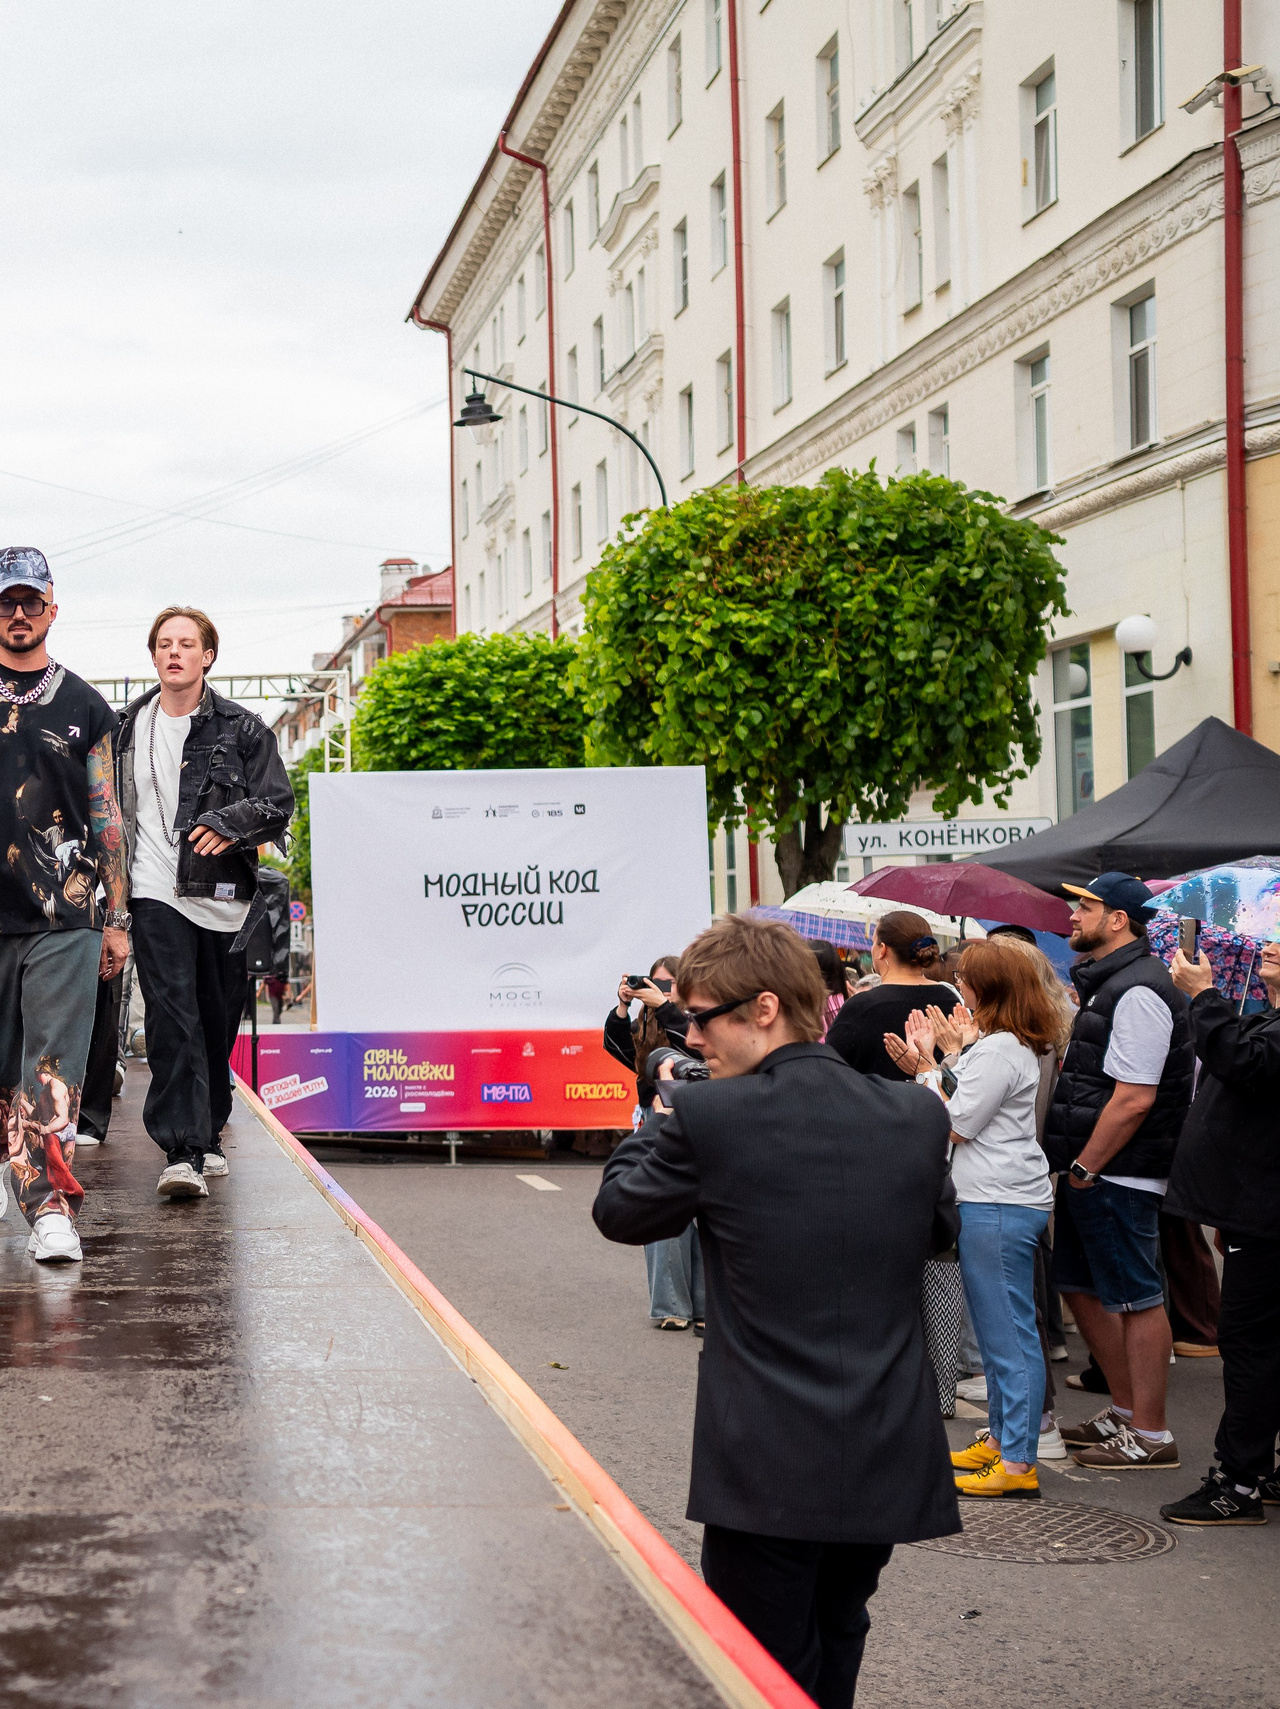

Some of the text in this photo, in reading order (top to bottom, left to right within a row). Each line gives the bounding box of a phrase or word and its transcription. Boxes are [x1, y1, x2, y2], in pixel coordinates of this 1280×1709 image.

[547, 809, 563, 817] 185
[858, 824, 1036, 852] ул. КОНЁНКОВА
[423, 865, 600, 897] МОДНЫЙ КОД
[461, 900, 564, 928] РОССИИ
[489, 991, 543, 1001] МОСТ
[363, 1048, 408, 1065] ДЕНЬ
[363, 1061, 455, 1081] МОЛОДЁЖИ
[364, 1086, 398, 1098] 2026
[565, 1083, 628, 1100] ГОРДОСТЬ
